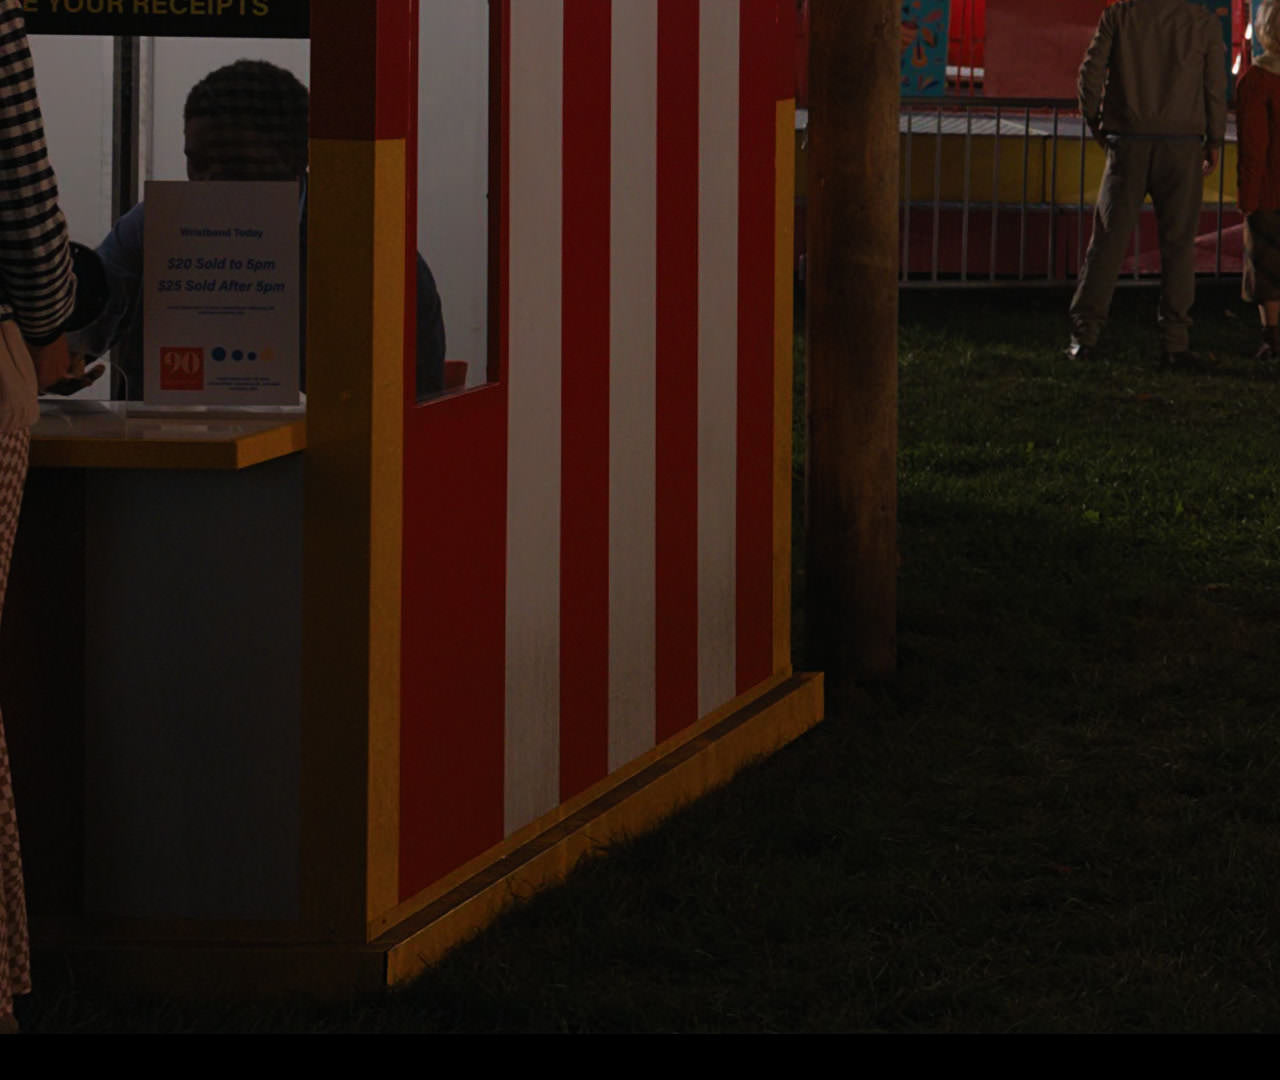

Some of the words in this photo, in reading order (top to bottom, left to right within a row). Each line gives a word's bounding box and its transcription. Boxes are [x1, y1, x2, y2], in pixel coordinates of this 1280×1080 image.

[167, 257, 192, 270] $20
[195, 257, 226, 270] Sold
[229, 259, 242, 270] to
[158, 280, 182, 292] $25
[185, 279, 216, 292] Sold
[218, 279, 252, 292] After
[256, 280, 286, 294] 5pm
